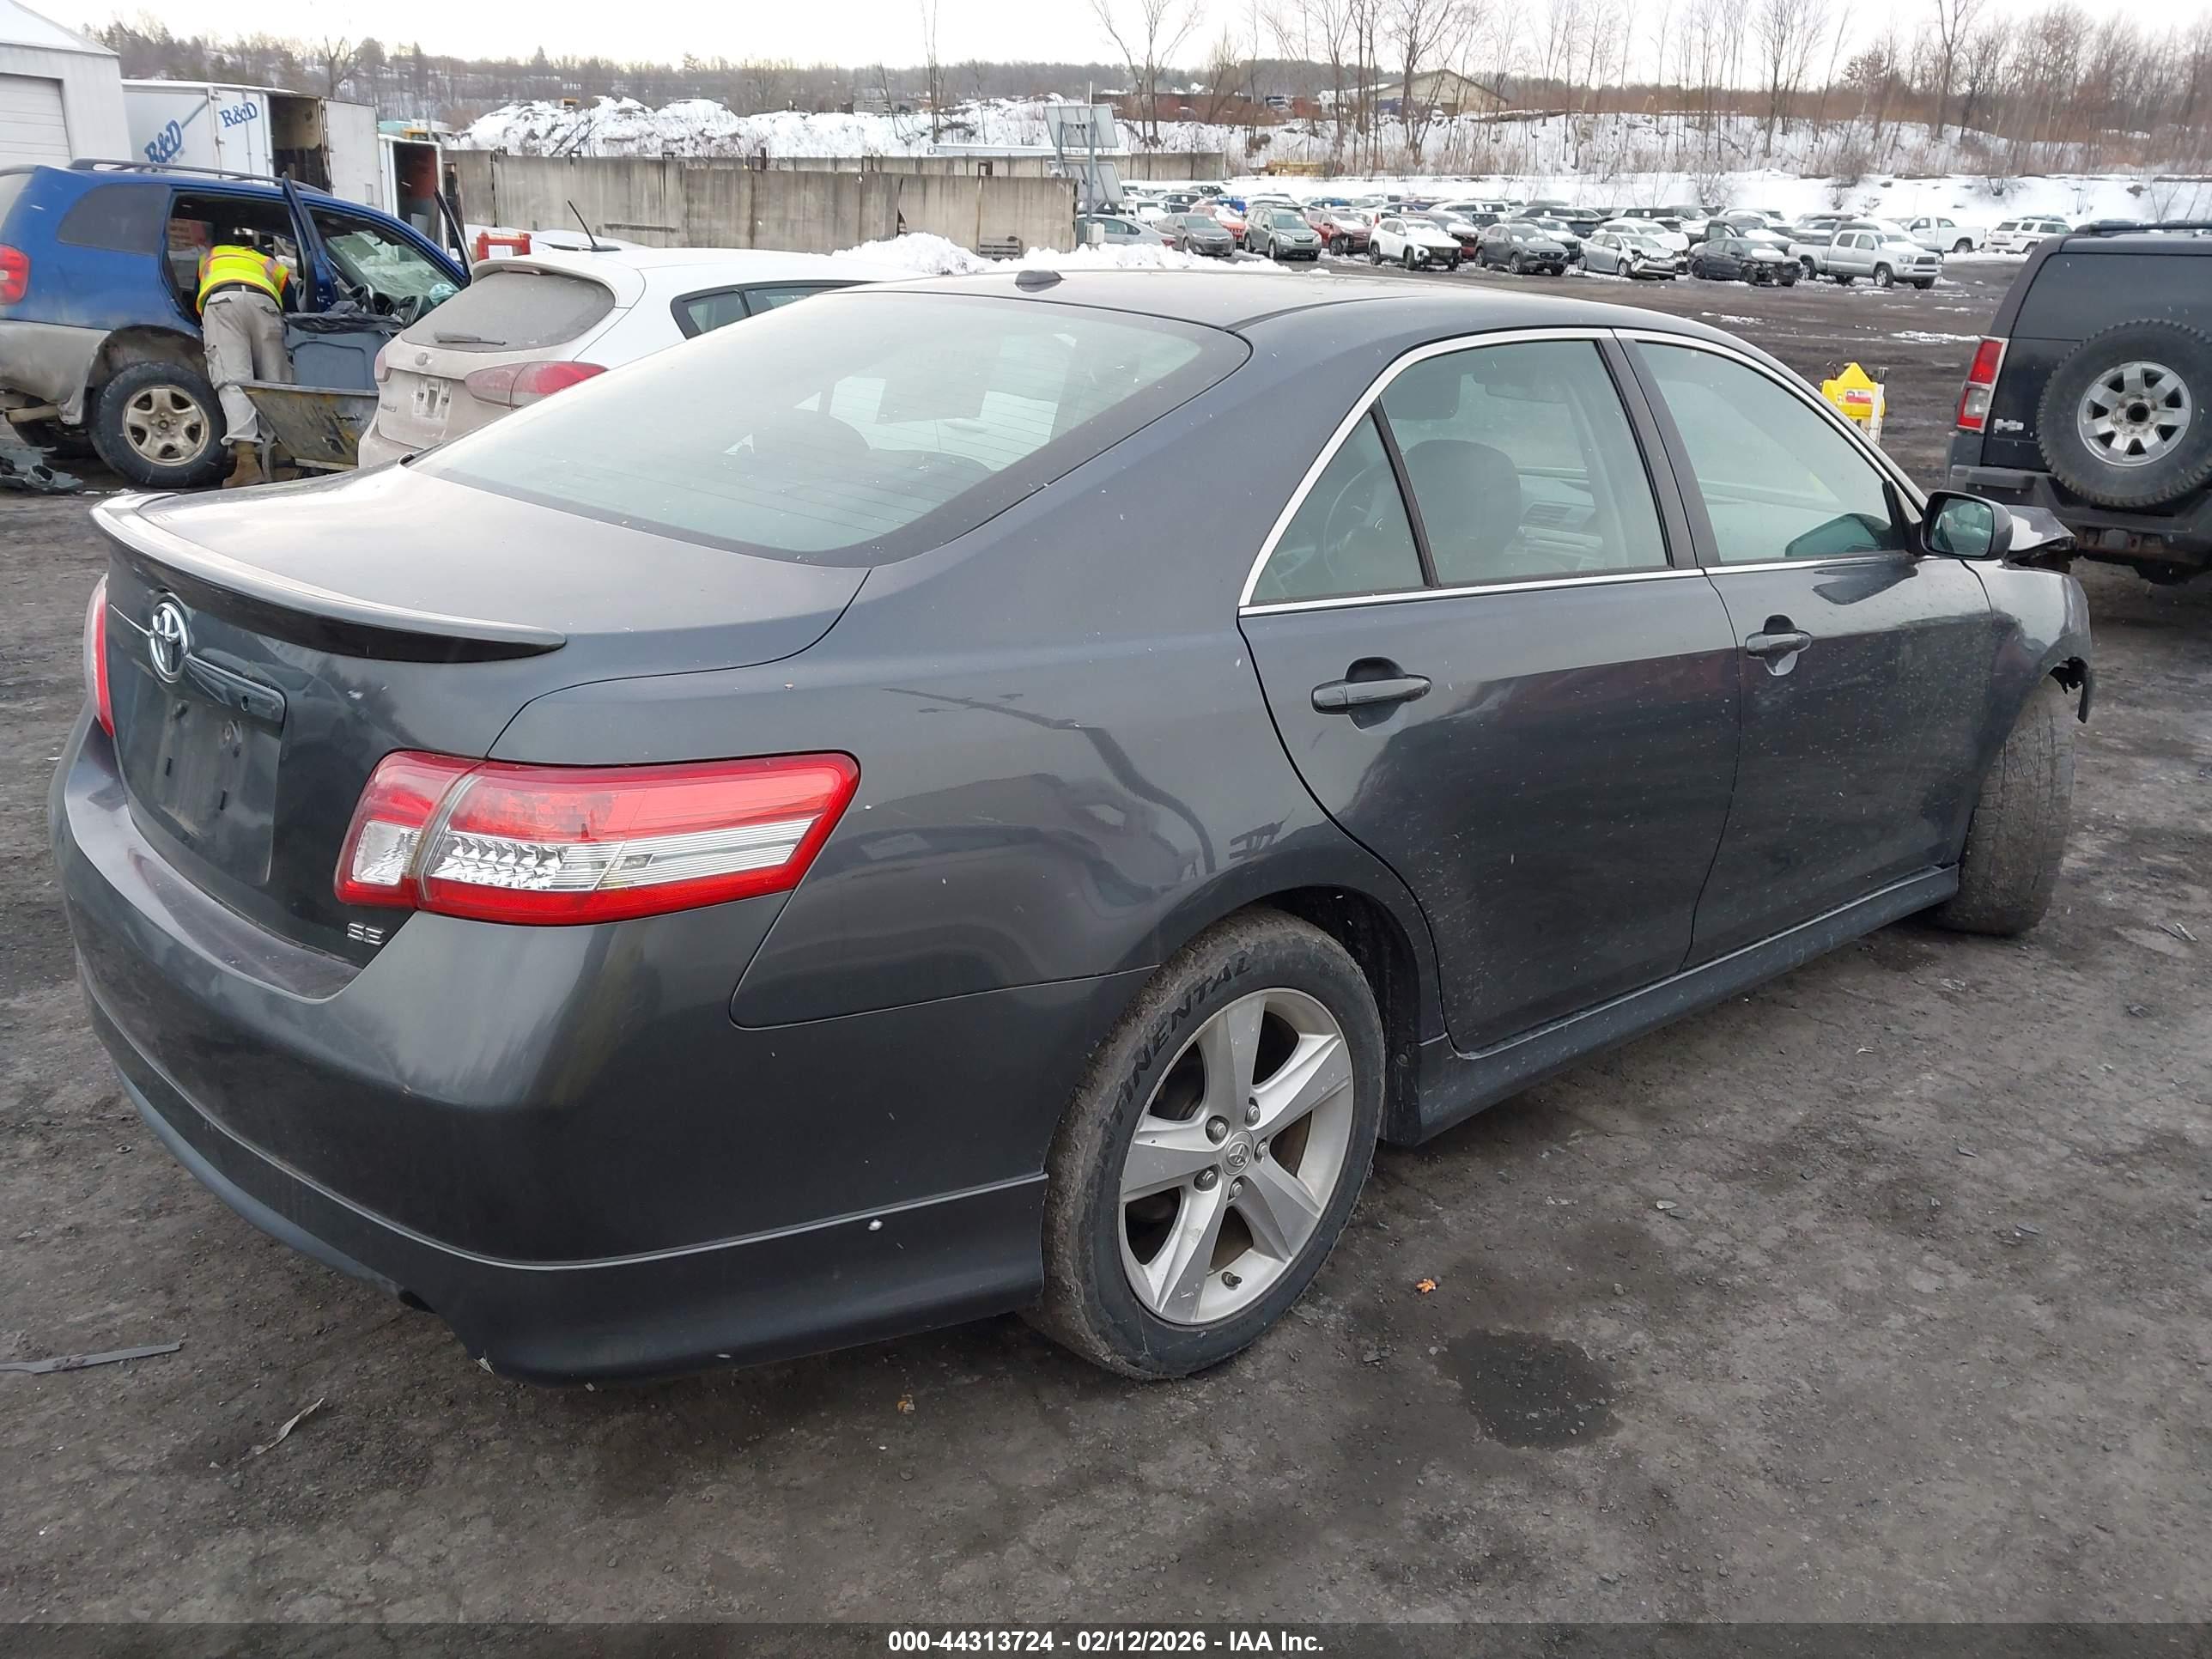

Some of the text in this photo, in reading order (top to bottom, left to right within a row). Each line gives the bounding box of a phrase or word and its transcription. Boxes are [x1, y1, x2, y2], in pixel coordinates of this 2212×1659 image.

[220, 102, 258, 127] R&D
[145, 120, 182, 163] R&D
[347, 922, 384, 945] SE
